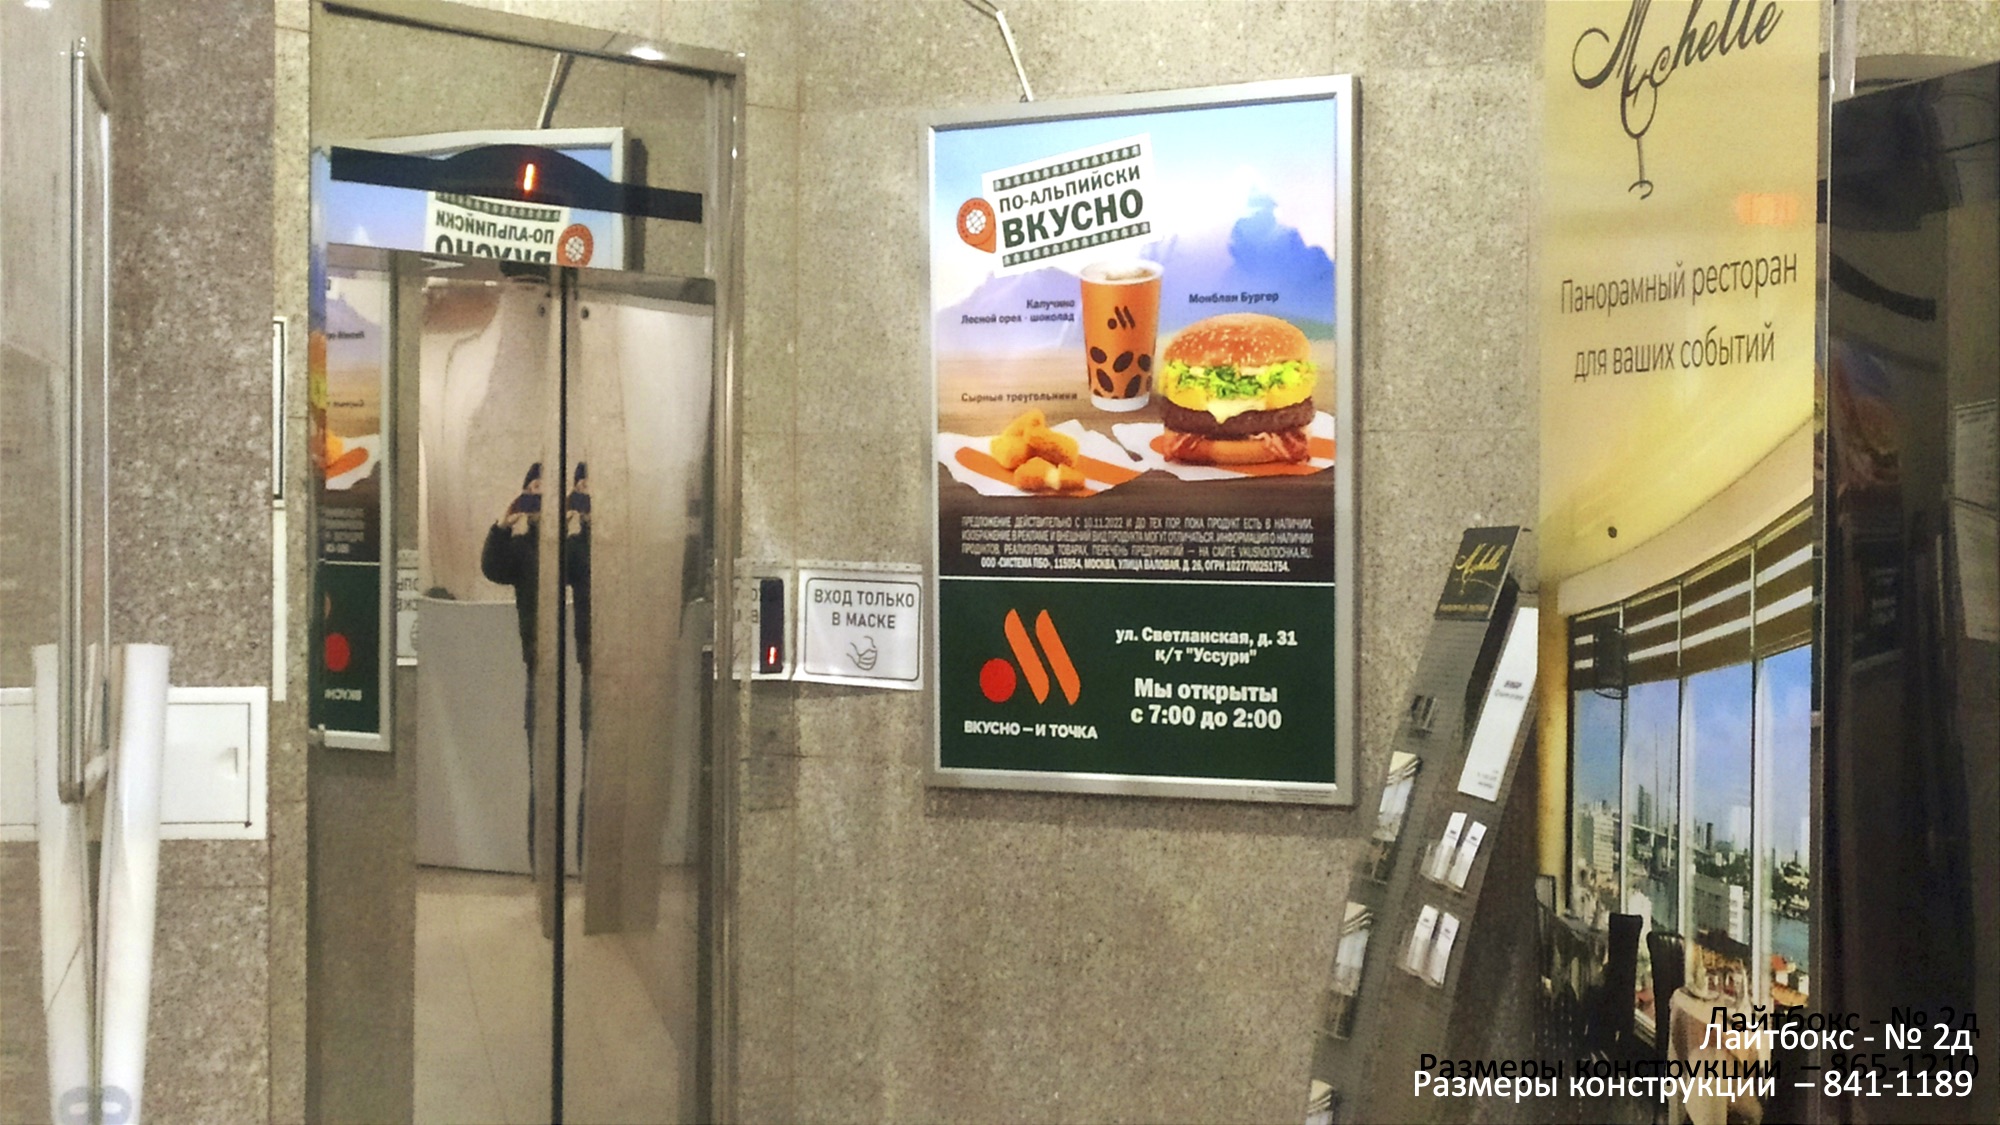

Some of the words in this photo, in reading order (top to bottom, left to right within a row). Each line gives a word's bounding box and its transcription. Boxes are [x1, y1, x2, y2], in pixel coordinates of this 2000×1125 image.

[999, 164, 1141, 214] ПО-АЛЬПИЙСКИ
[1002, 188, 1144, 248] ВКУСНО
[1561, 260, 1686, 317] Панорамный
[1692, 253, 1797, 306] ресторан
[1189, 292, 1237, 304] Монблан
[1240, 290, 1279, 304] Бургер
[961, 313, 997, 324] Лесной
[1030, 313, 1075, 322] шоколад
[1574, 349, 1607, 383] для
[1613, 341, 1675, 375] ваших
[1680, 322, 1775, 369] событий
[961, 393, 1003, 403] Сырные
[1007, 393, 1077, 403] треугольники
[815, 589, 852, 606] ВХОД
[857, 591, 914, 607] ТОЛЬКО
[832, 612, 840, 625] В
[847, 613, 896, 629] МАСКЕ
[1115, 628, 1139, 644] ул.
[1142, 626, 1253, 646] Светланская,
[1257, 631, 1273, 648] д.
[1276, 630, 1297, 647] 31
[1155, 648, 1183, 665] к/т
[1186, 647, 1257, 666] "Уссури"
[1135, 678, 1172, 698] Мы
[1177, 684, 1278, 705] открыты
[1131, 708, 1143, 724] с
[1148, 704, 1196, 726] 7:00
[1200, 711, 1228, 730] до
[1232, 708, 1282, 730] 2:00
[964, 720, 1020, 737] ВКУСНО
[1035, 724, 1045, 737] И
[1049, 724, 1098, 740] ТОЧКА
